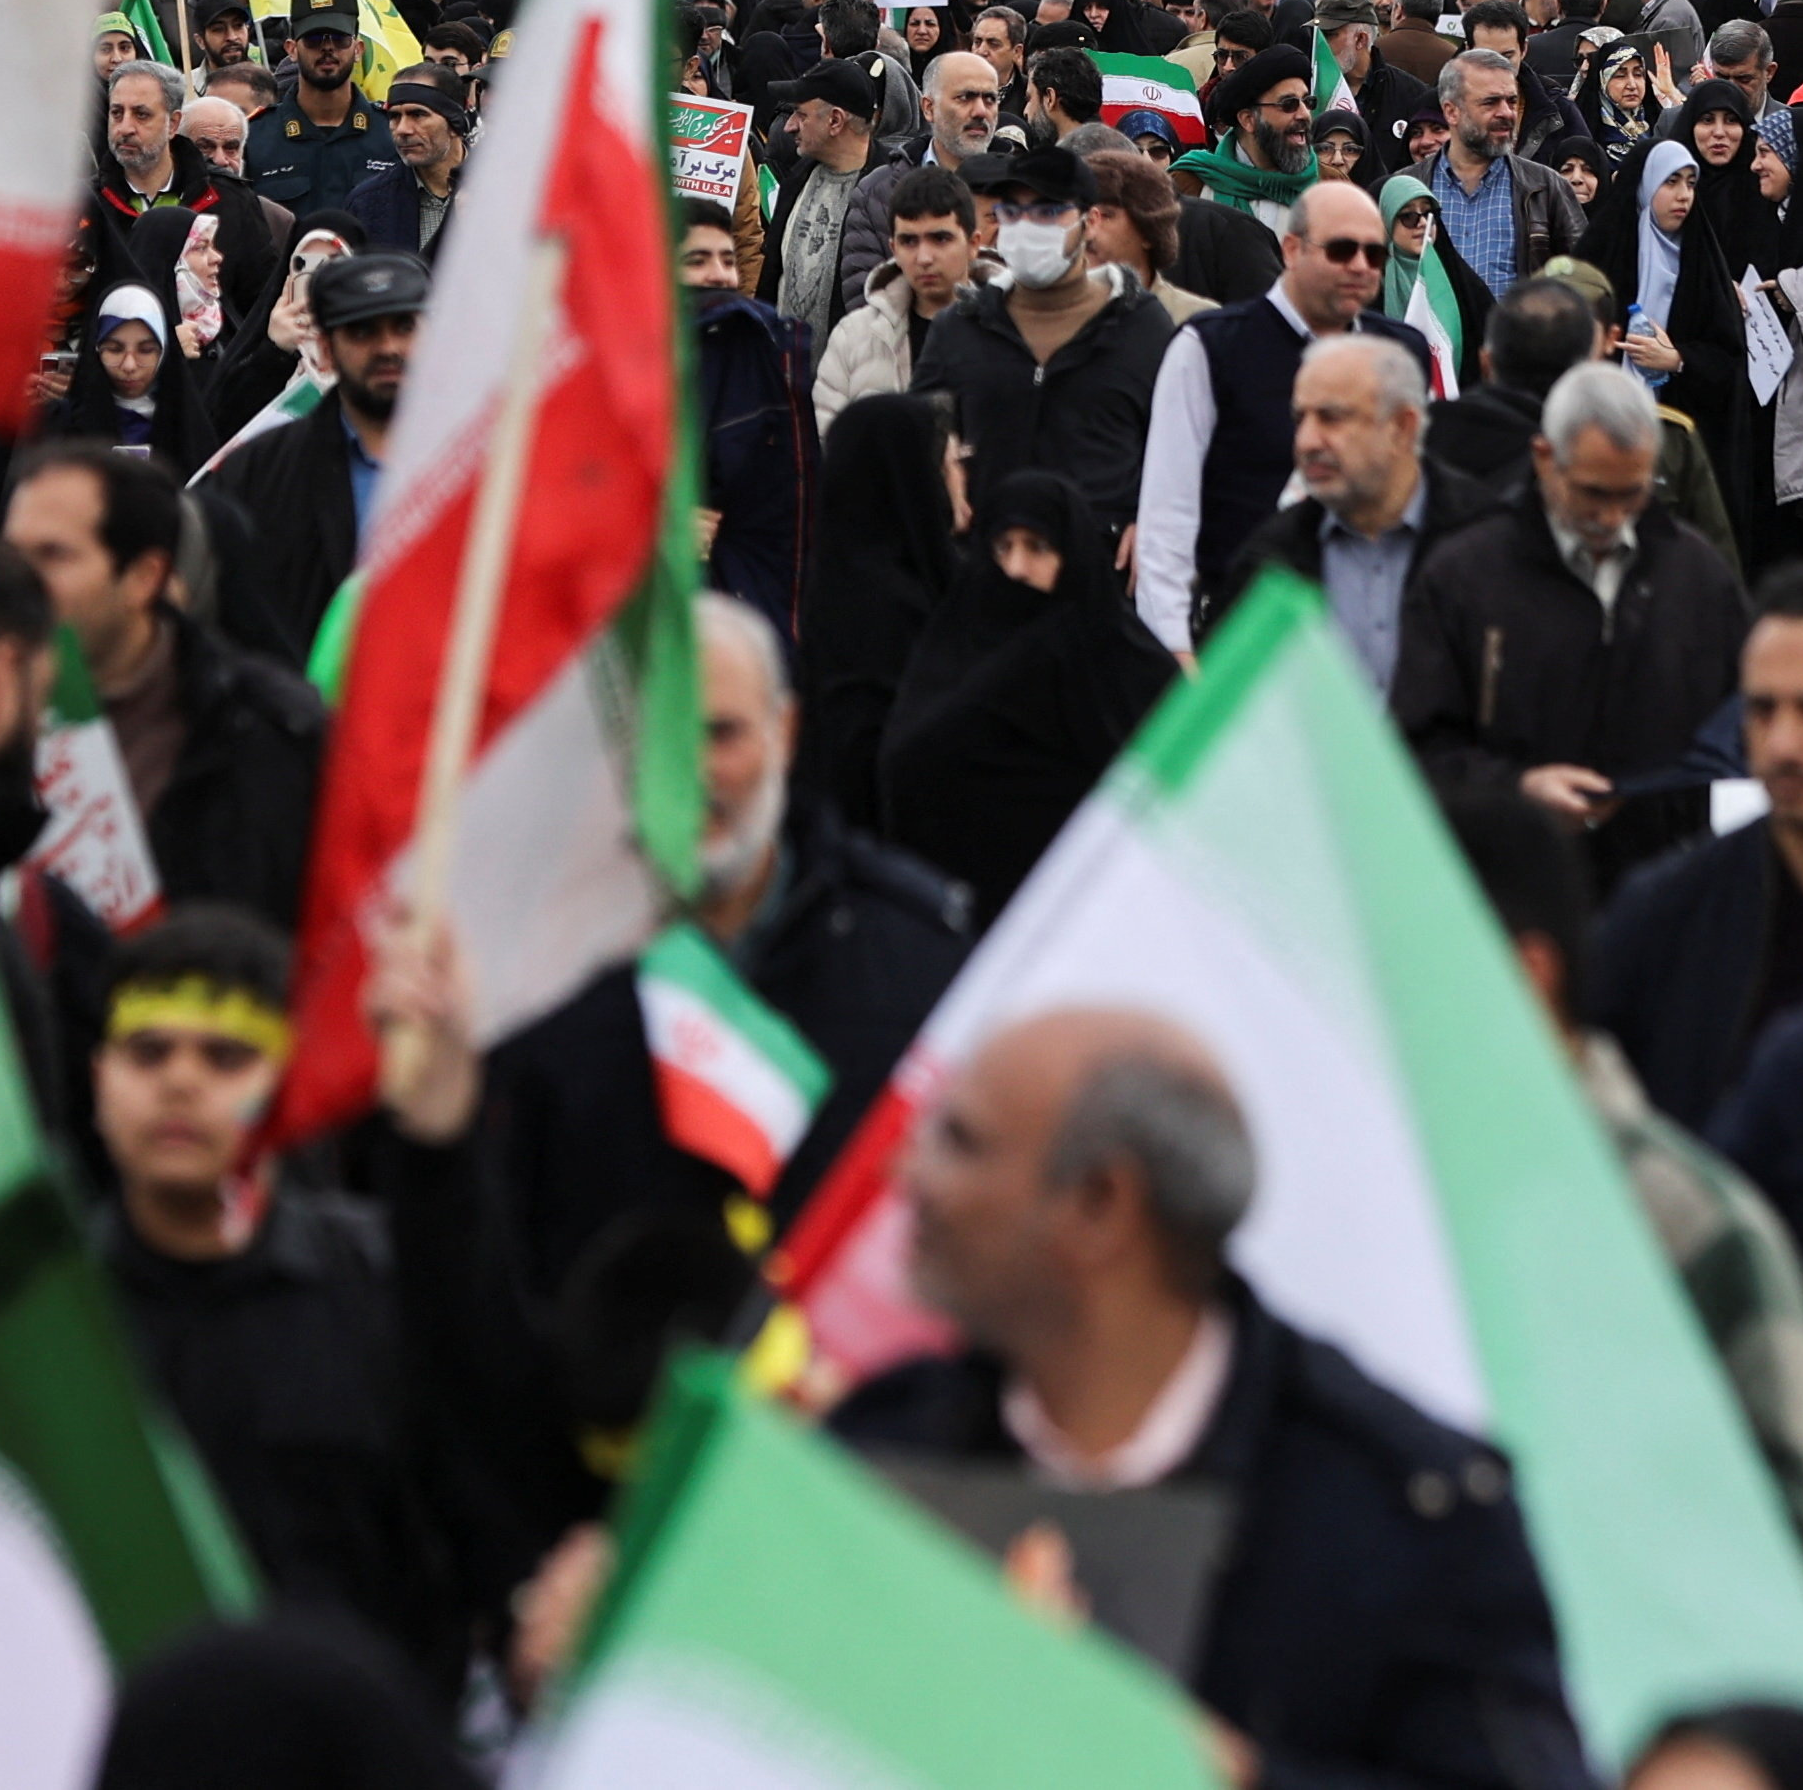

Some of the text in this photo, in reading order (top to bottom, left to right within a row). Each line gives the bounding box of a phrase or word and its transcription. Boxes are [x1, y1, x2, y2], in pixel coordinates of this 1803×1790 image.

[684, 159, 702, 177] بر
[704, 159, 737, 182] مرگ
[701, 181, 731, 196] U.S.A
